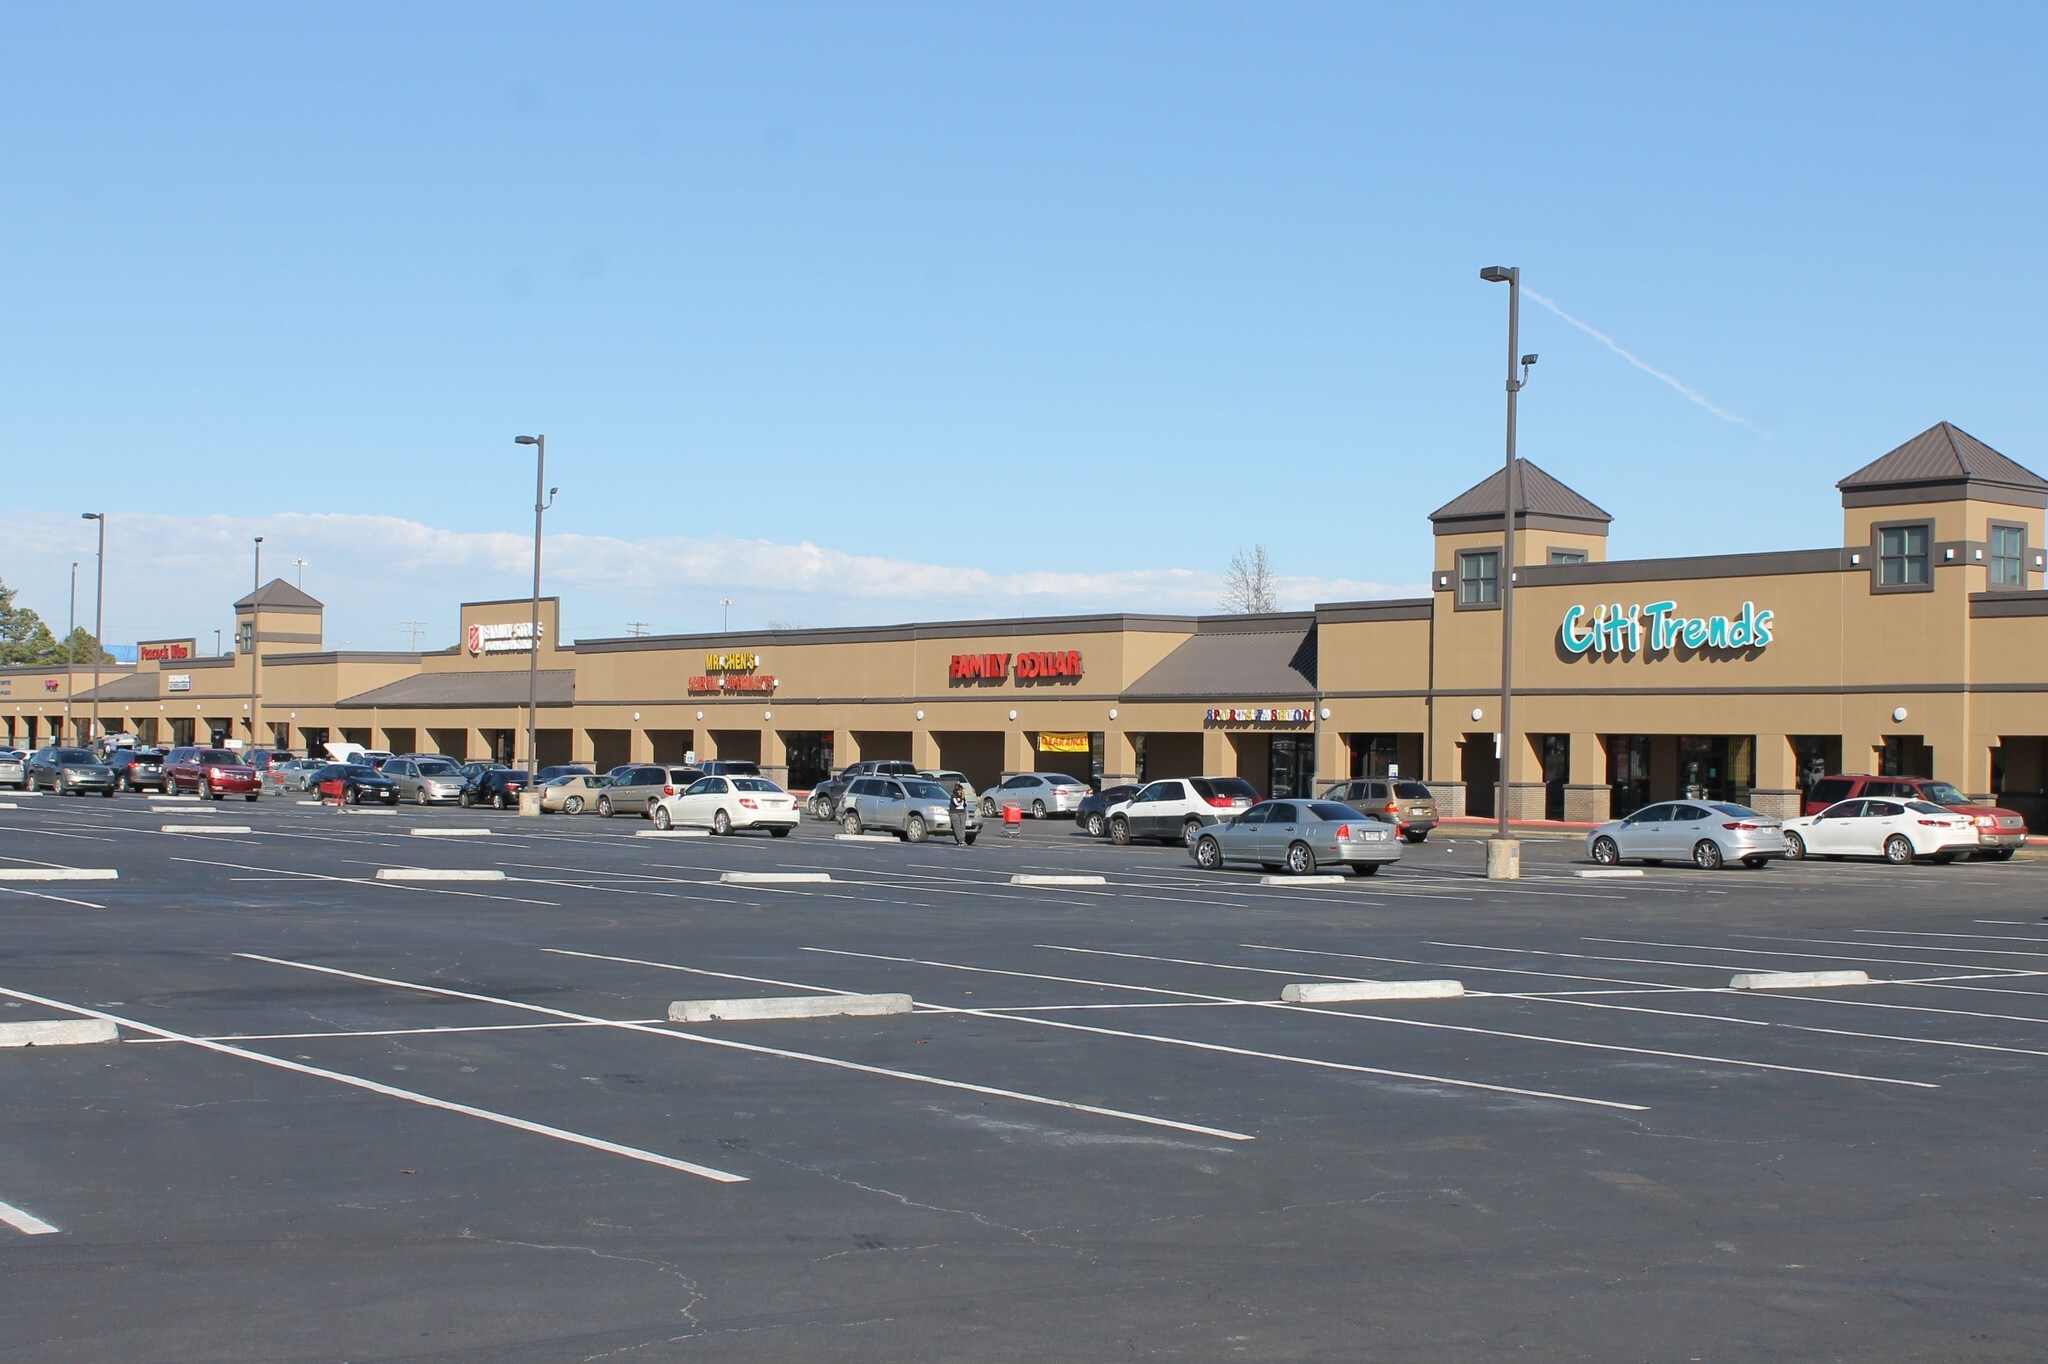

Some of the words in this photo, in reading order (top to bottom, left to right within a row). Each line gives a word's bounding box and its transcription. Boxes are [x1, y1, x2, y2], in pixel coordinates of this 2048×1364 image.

[1561, 603, 1641, 653] Citi
[1644, 600, 1774, 650] Trends
[950, 653, 1011, 679] FAMILY
[1017, 650, 1082, 678] DOLLAR
[1207, 709, 1254, 721] SPORTS
[1256, 709, 1313, 721] FASHION
